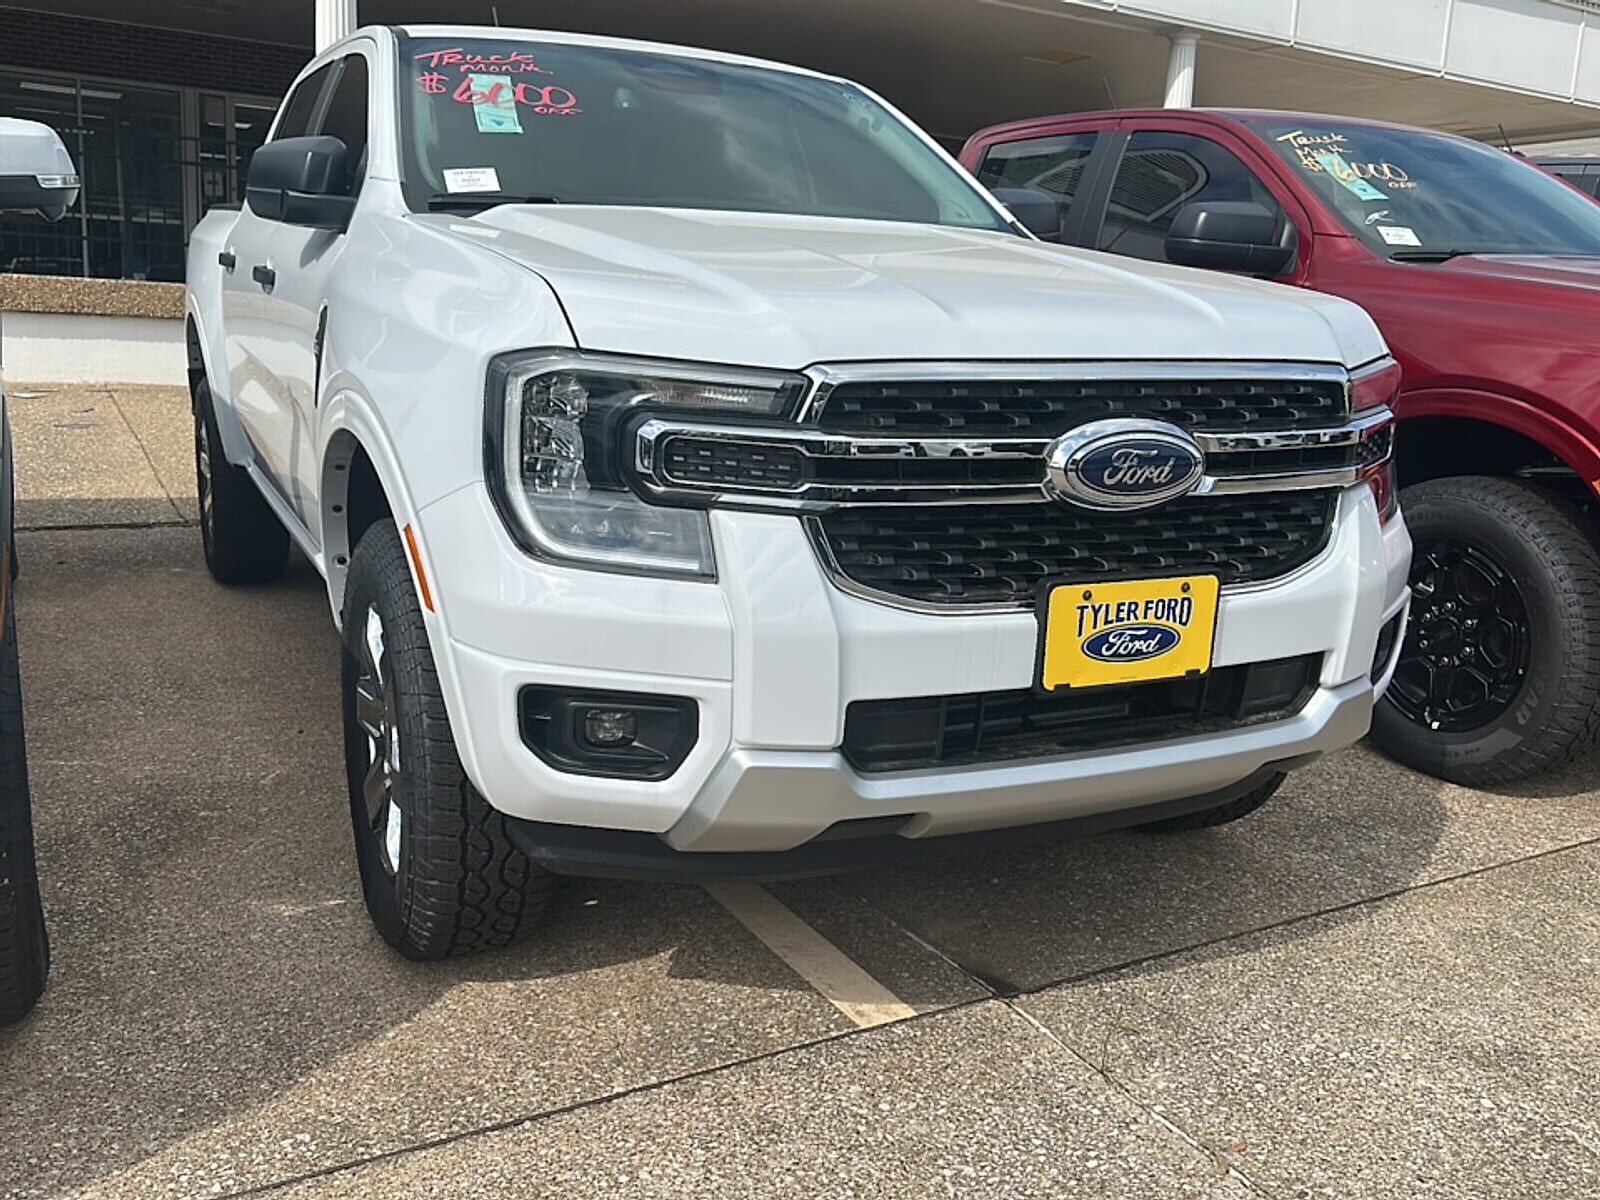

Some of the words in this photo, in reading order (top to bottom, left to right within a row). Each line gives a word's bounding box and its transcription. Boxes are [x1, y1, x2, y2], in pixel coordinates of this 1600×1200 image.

[1103, 448, 1174, 485] Ford
[1076, 601, 1138, 637] TYLER
[1143, 597, 1192, 627] FORD
[1100, 629, 1160, 656] Ford
